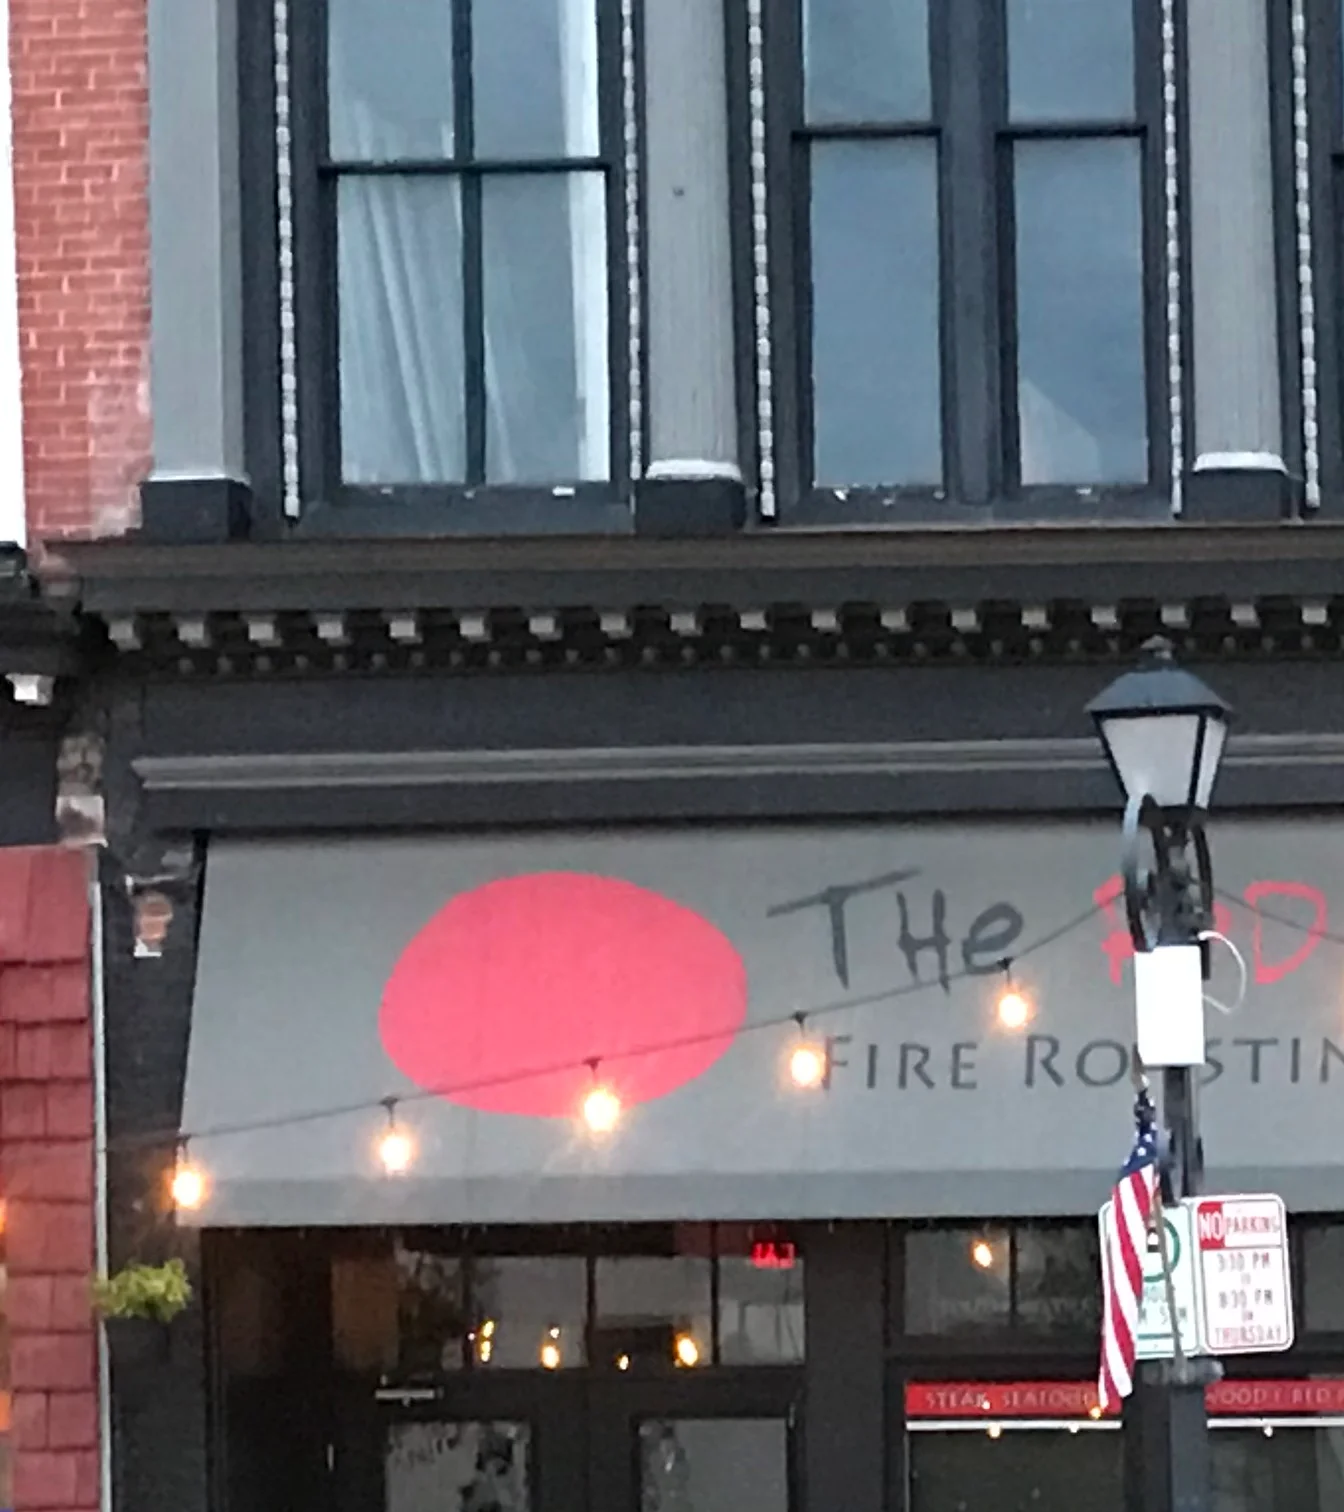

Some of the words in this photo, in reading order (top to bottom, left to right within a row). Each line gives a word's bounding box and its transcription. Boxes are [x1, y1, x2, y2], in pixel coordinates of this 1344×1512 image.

[822, 1035, 979, 1091] FIRE
[1199, 1210, 1225, 1242] NO
[1225, 1216, 1281, 1235] PARKING
[1252, 1251, 1271, 1269] PM
[1214, 1324, 1282, 1345] THURSDAY
[926, 1391, 989, 1408] STEAK
